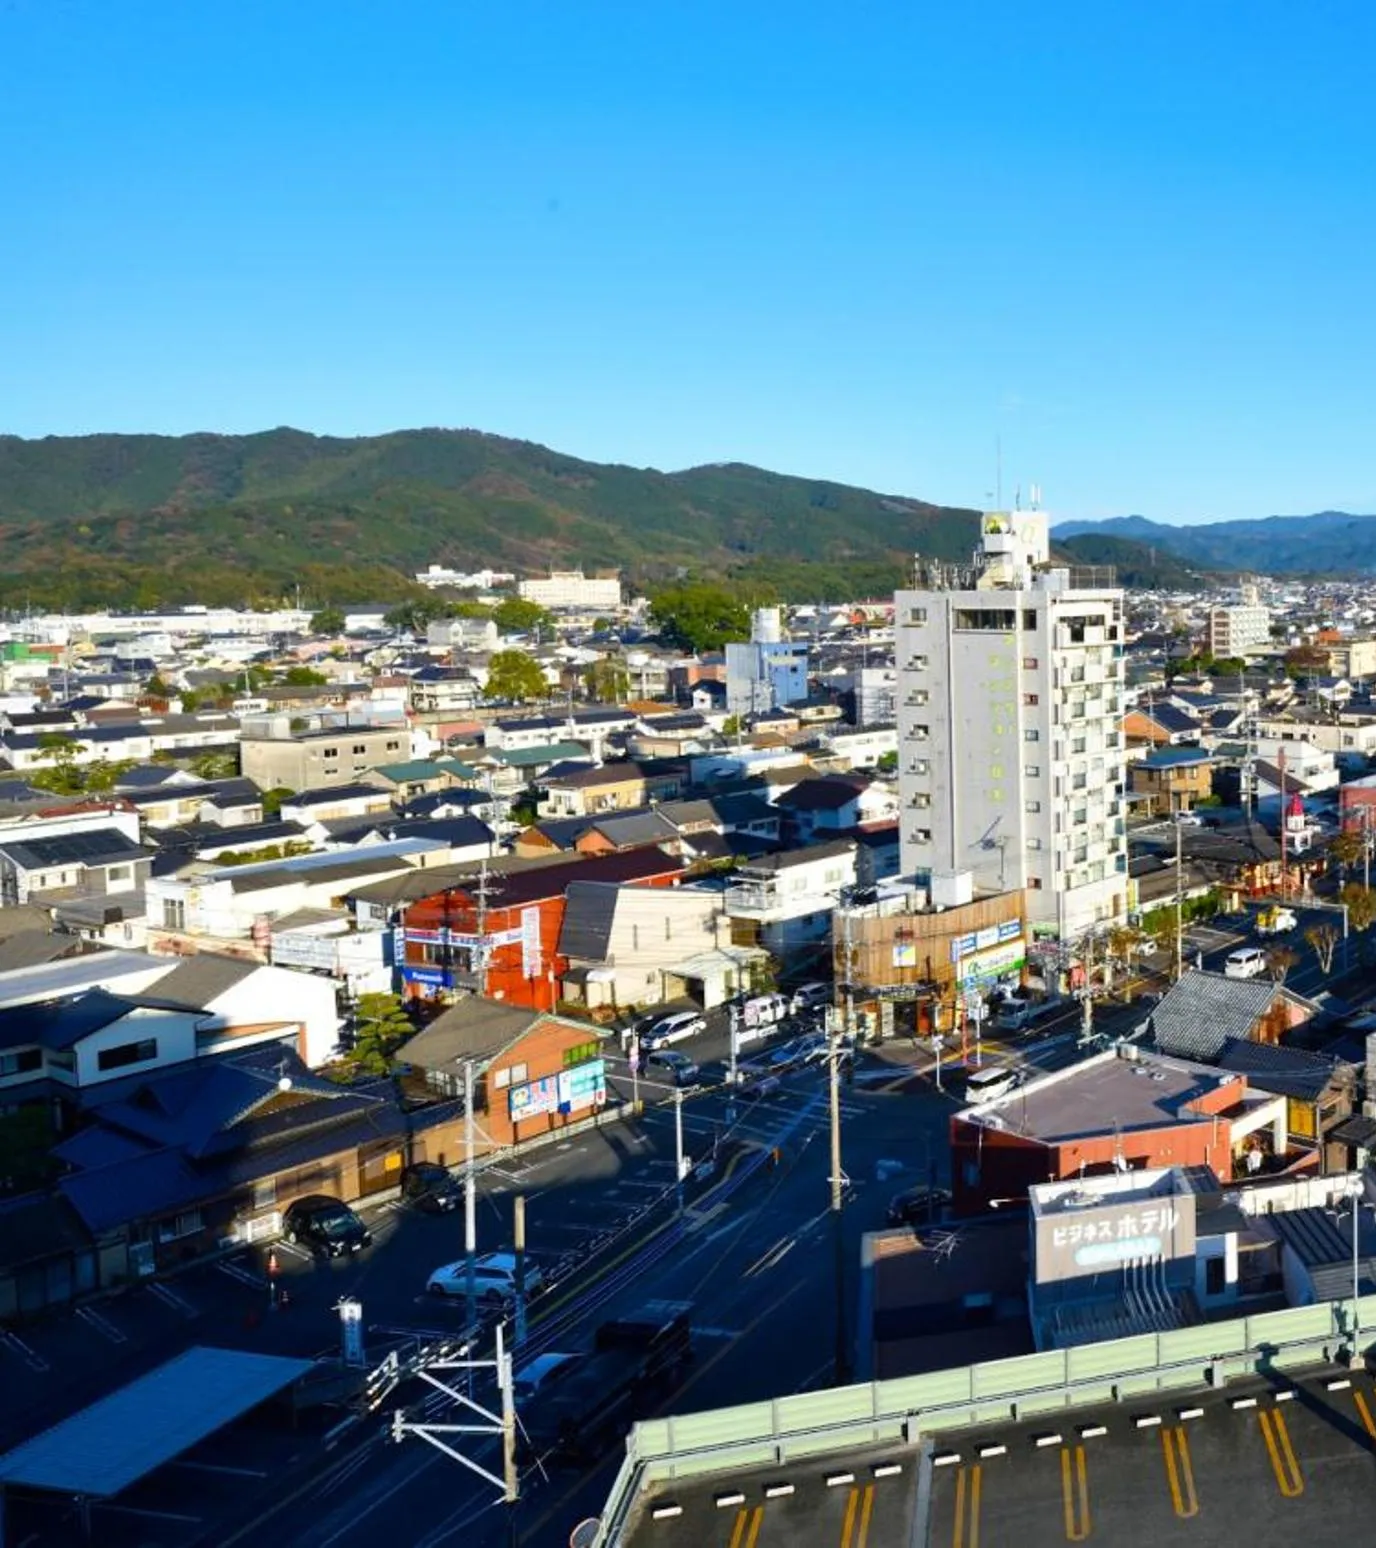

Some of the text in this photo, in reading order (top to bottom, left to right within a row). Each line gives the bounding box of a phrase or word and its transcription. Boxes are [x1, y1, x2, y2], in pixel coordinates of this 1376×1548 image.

[1053, 1207, 1180, 1247] ビジネスホテル
